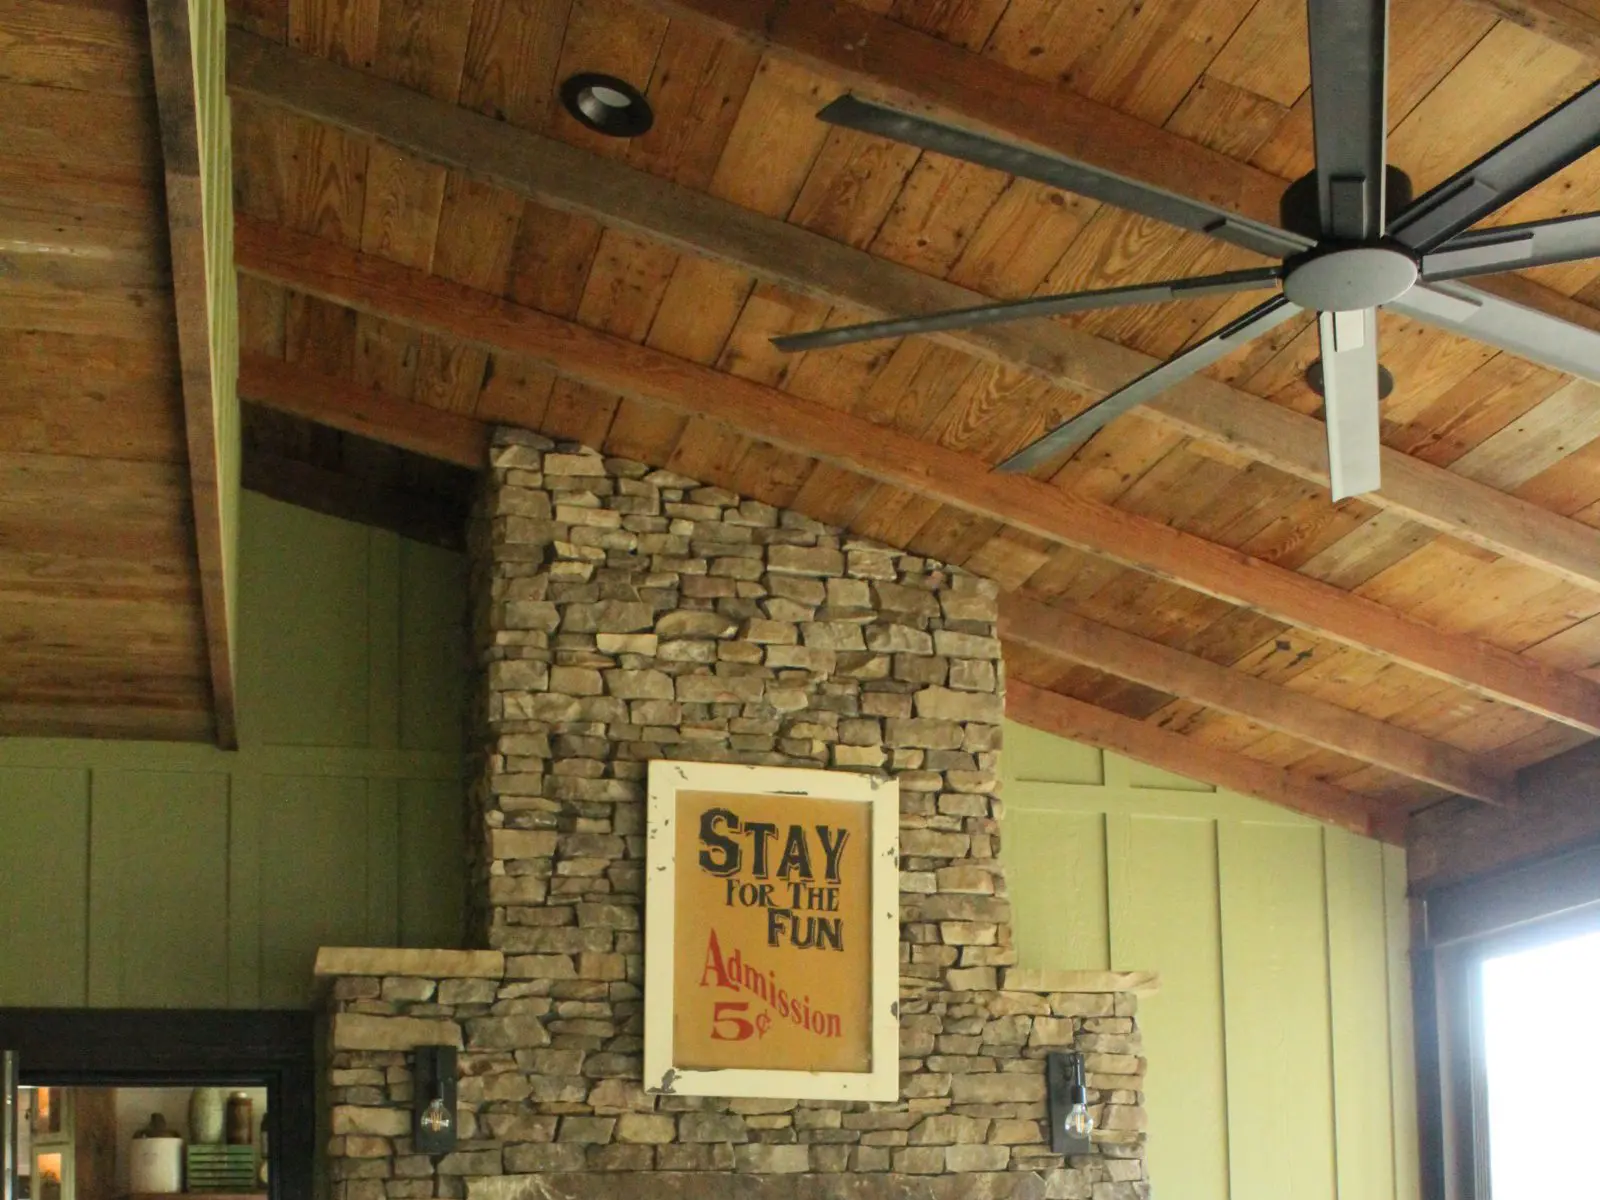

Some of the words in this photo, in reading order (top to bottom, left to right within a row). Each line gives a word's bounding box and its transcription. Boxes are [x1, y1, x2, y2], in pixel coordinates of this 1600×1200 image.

[699, 807, 850, 884] STAY
[725, 879, 778, 908] FOR
[787, 881, 840, 912] THE
[767, 907, 845, 952] FUN
[700, 928, 842, 1038] Admission
